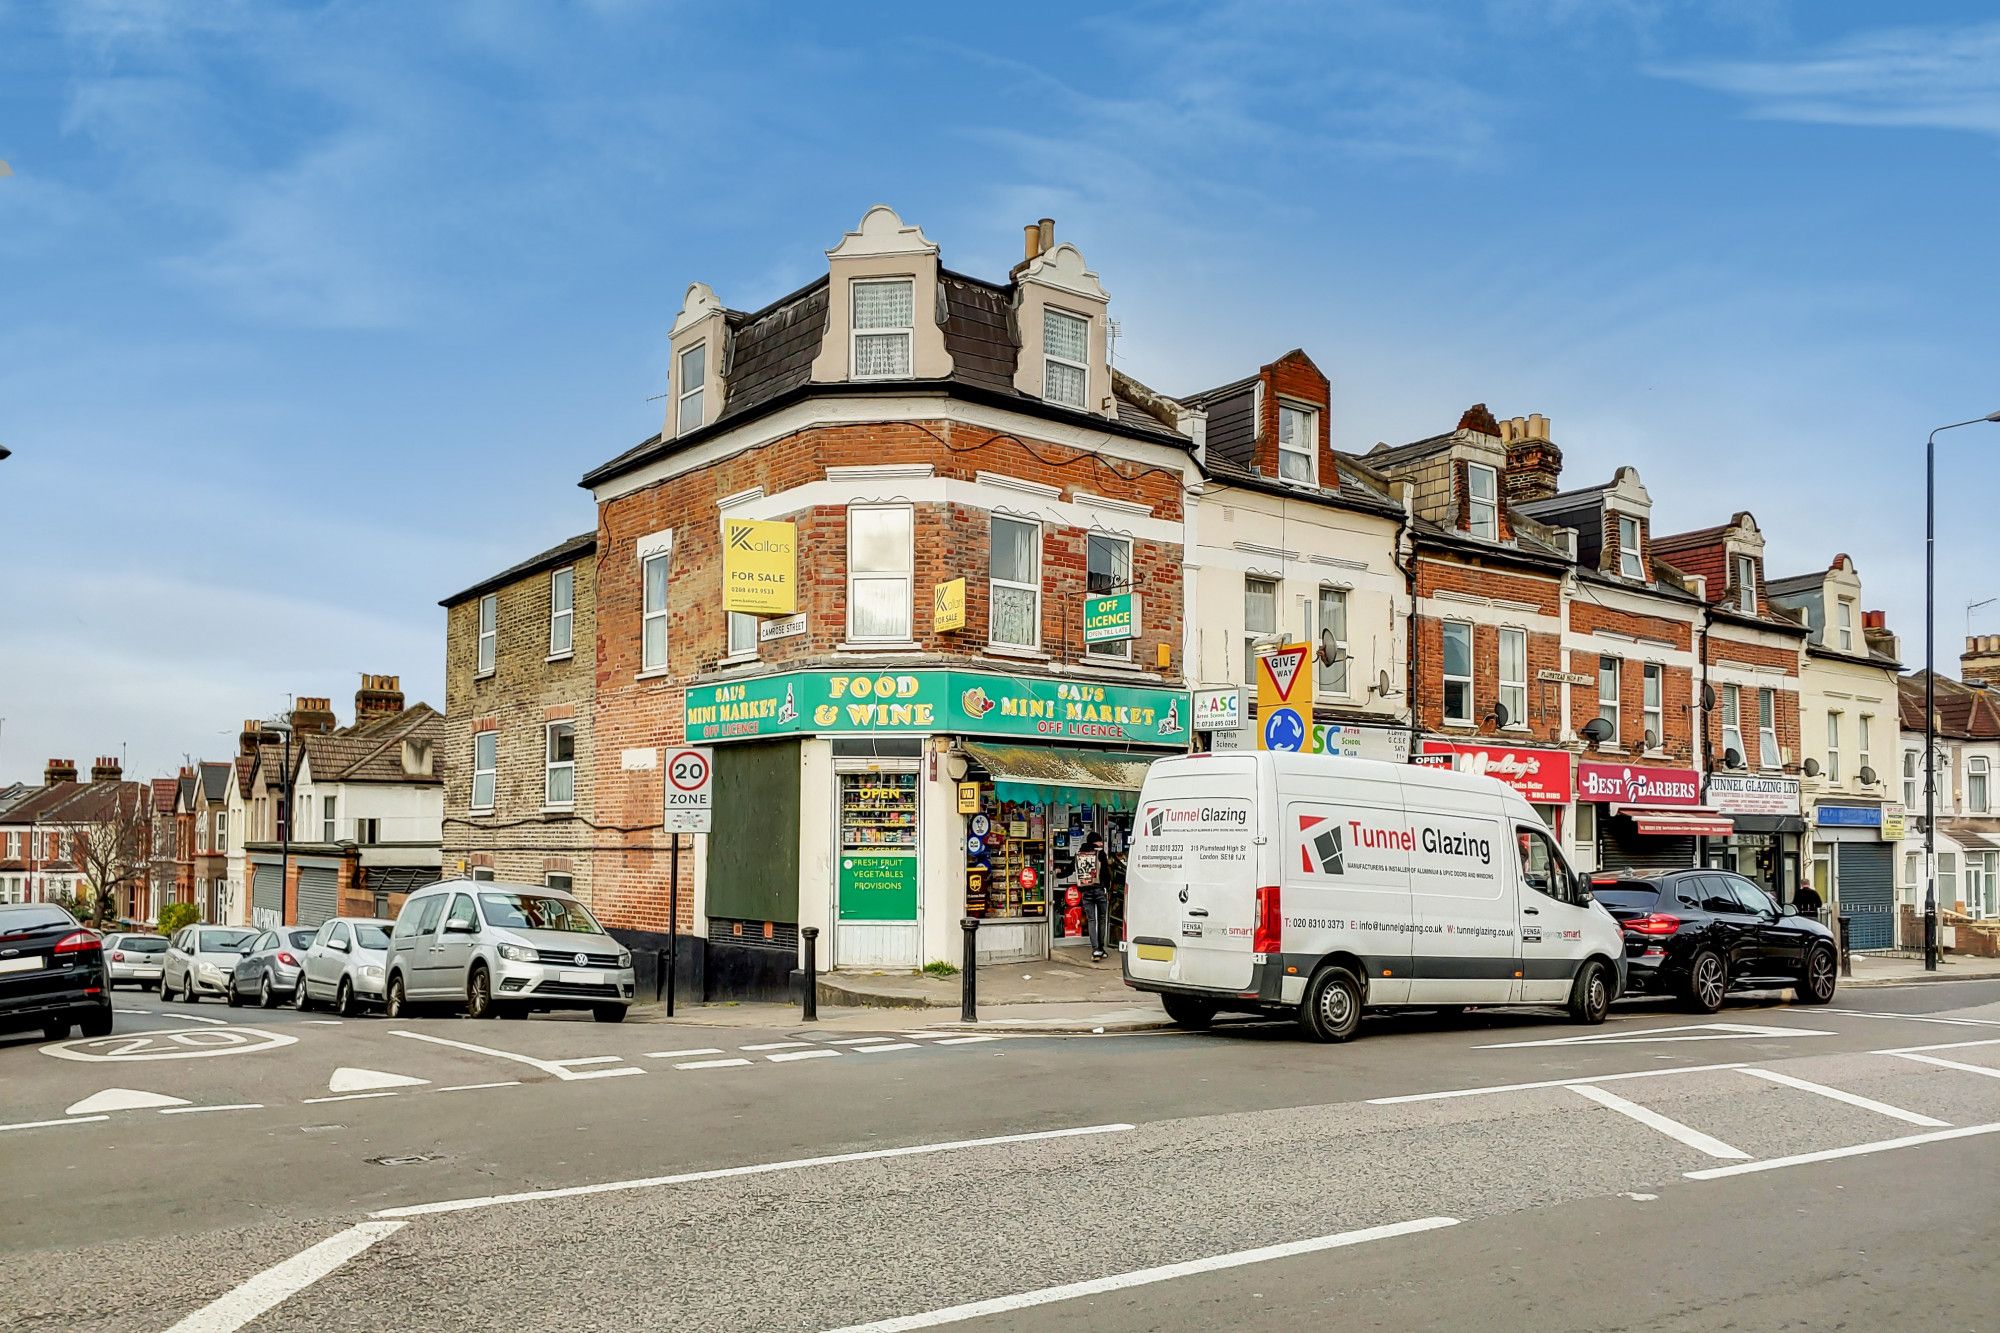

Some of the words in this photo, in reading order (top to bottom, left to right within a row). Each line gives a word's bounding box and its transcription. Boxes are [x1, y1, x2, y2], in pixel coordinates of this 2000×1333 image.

[731, 571, 754, 581] FOR
[758, 573, 785, 583] SALE
[1098, 599, 1118, 613] OFF
[936, 616, 945, 624] FOR
[945, 613, 957, 622] SALE
[1087, 612, 1130, 628] LICENCE
[762, 624, 785, 638] CAMROSE
[786, 621, 804, 633] STREET
[1088, 630, 1102, 638] OPEN
[1115, 626, 1128, 634] LATE
[1271, 655, 1296, 668] GIVE
[1276, 669, 1293, 678] WAY
[829, 676, 919, 698] FOOD
[1058, 684, 1104, 702] SAL'S
[687, 705, 716, 725] MINI
[720, 697, 777, 722] MARKET
[1000, 696, 1055, 718] MINI
[1066, 702, 1155, 725] MARKET
[1210, 695, 1237, 712] ASC
[814, 704, 838, 726] &
[846, 703, 935, 726] WINE
[703, 724, 719, 738] OFF
[722, 720, 759, 735] LICENCE
[1037, 721, 1063, 735] OFF
[1069, 722, 1123, 738] LICENCE
[1216, 730, 1237, 740] English
[1216, 740, 1238, 749] Science
[1313, 724, 1341, 756] SC
[1415, 756, 1444, 764] OPEN
[674, 763, 703, 779] 20
[1582, 771, 1622, 795] BEST
[1637, 774, 1695, 799] BARBERS
[1710, 778, 1744, 791] TUNNEL
[1745, 780, 1782, 793] GLAZING
[1783, 781, 1798, 794] LTD
[670, 794, 707, 804] ZONE
[860, 788, 901, 799] OPEN
[1165, 808, 1200, 822] Tunnel
[1201, 807, 1247, 825] Glazing
[1226, 845, 1239, 853] High
[1348, 820, 1417, 851] Tunnel
[1422, 827, 1490, 865] Glazing
[1200, 853, 1219, 861] London
[1347, 862, 1385, 872] MANUFACTURERS
[1453, 870, 1467, 878] DOORS
[854, 882, 902, 890] PROVISIONS
[1228, 927, 1253, 936] smart
[1284, 917, 1291, 928] T:
[1293, 918, 1307, 928] 020
[1308, 918, 1326, 929] 8310
[1327, 919, 1345, 930] 3373
[1350, 920, 1358, 930] E:
[1359, 920, 1443, 934] info@tunnelglazing.co.uk
[1446, 924, 1456, 934] W:
[1457, 926, 1514, 938] tunnelglazing.co.uk
[1563, 929, 1581, 939] smart
[88, 1031, 248, 1056] 20
